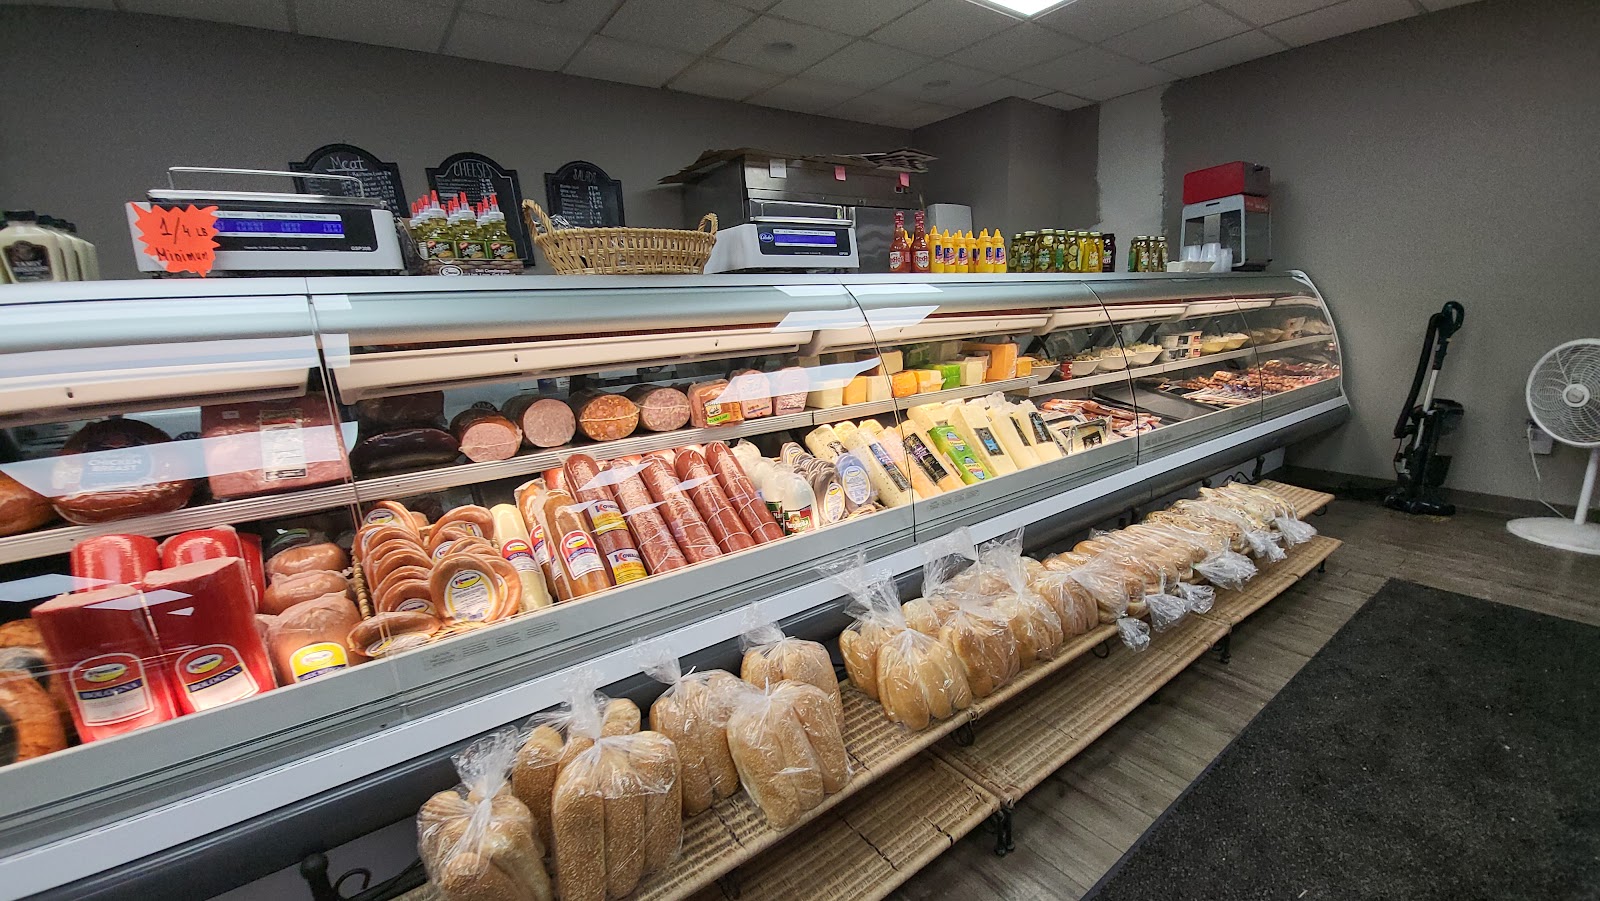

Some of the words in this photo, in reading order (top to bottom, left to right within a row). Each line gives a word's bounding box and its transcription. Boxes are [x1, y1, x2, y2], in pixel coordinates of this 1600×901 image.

[329, 155, 365, 171] Meat
[453, 162, 493, 179] CHEESES
[196, 227, 209, 237] LB
[155, 247, 208, 262] Minimum
